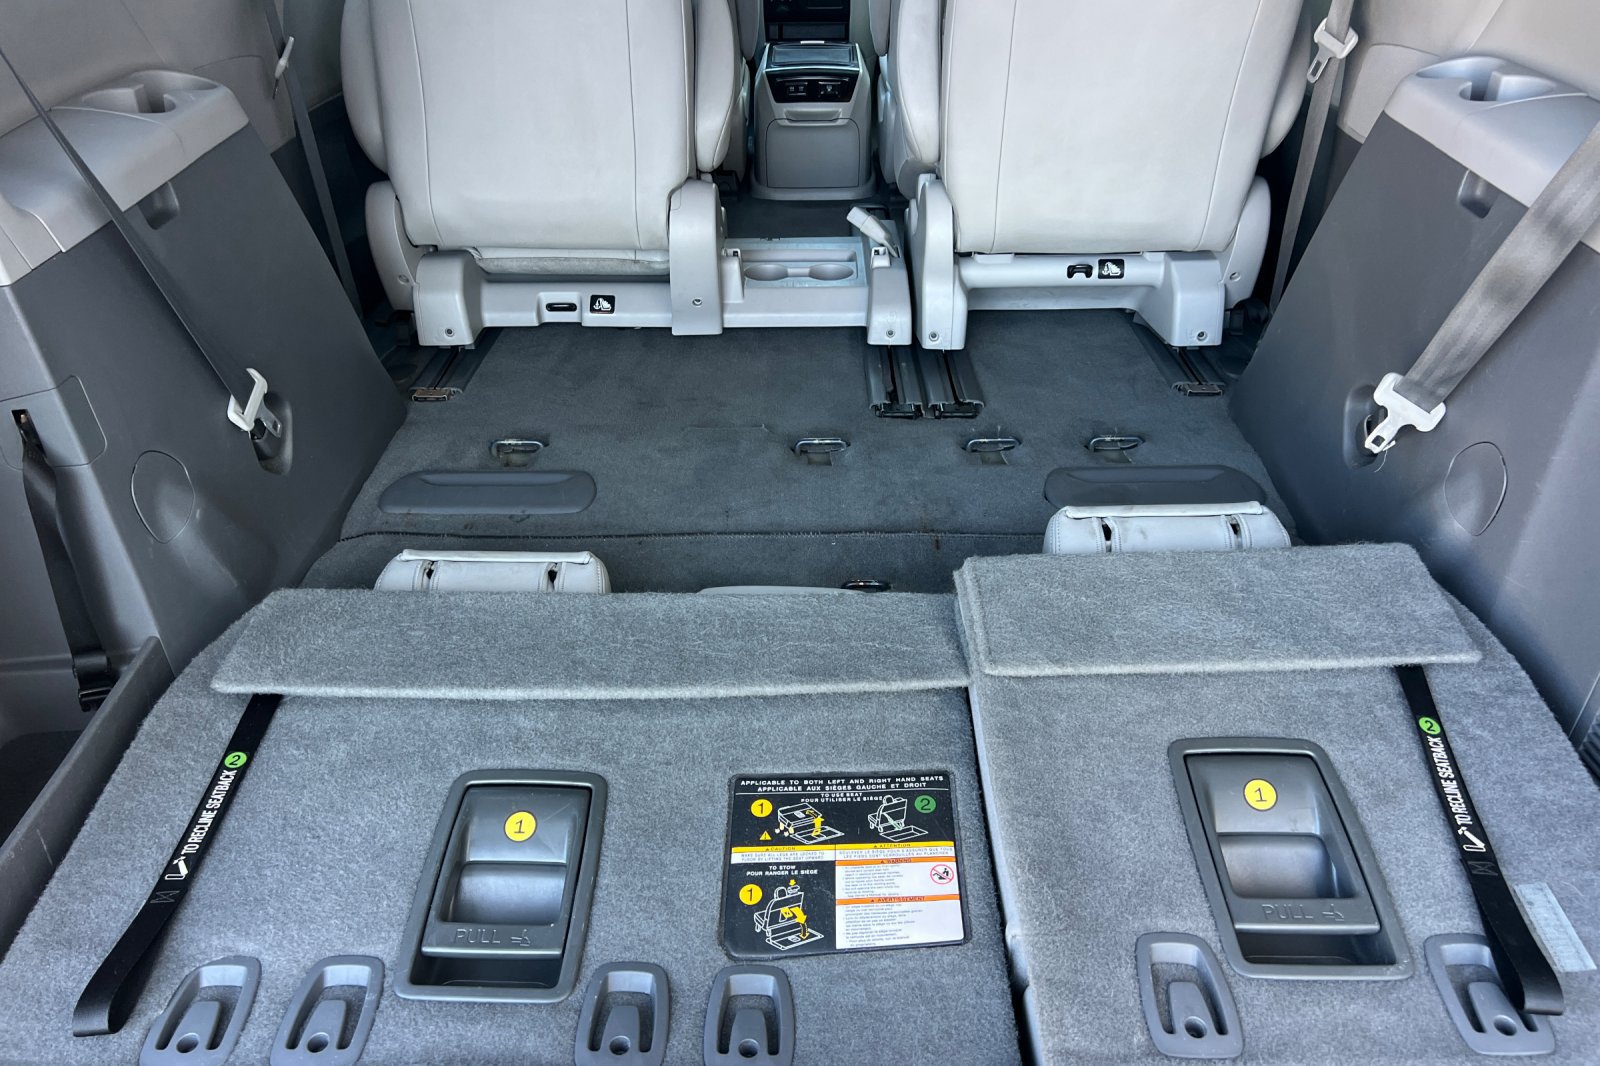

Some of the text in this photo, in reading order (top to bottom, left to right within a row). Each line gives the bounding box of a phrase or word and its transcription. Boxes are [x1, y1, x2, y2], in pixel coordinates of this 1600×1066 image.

[1427, 735, 1455, 780] SEATBACK
[205, 769, 237, 810] SEATBACK
[1440, 779, 1469, 815] RECLINE
[187, 809, 218, 843] RECLINE
[1454, 813, 1473, 825] TO
[181, 843, 200, 855] TO
[1261, 903, 1314, 921] PULL
[454, 928, 501, 943] PULL
